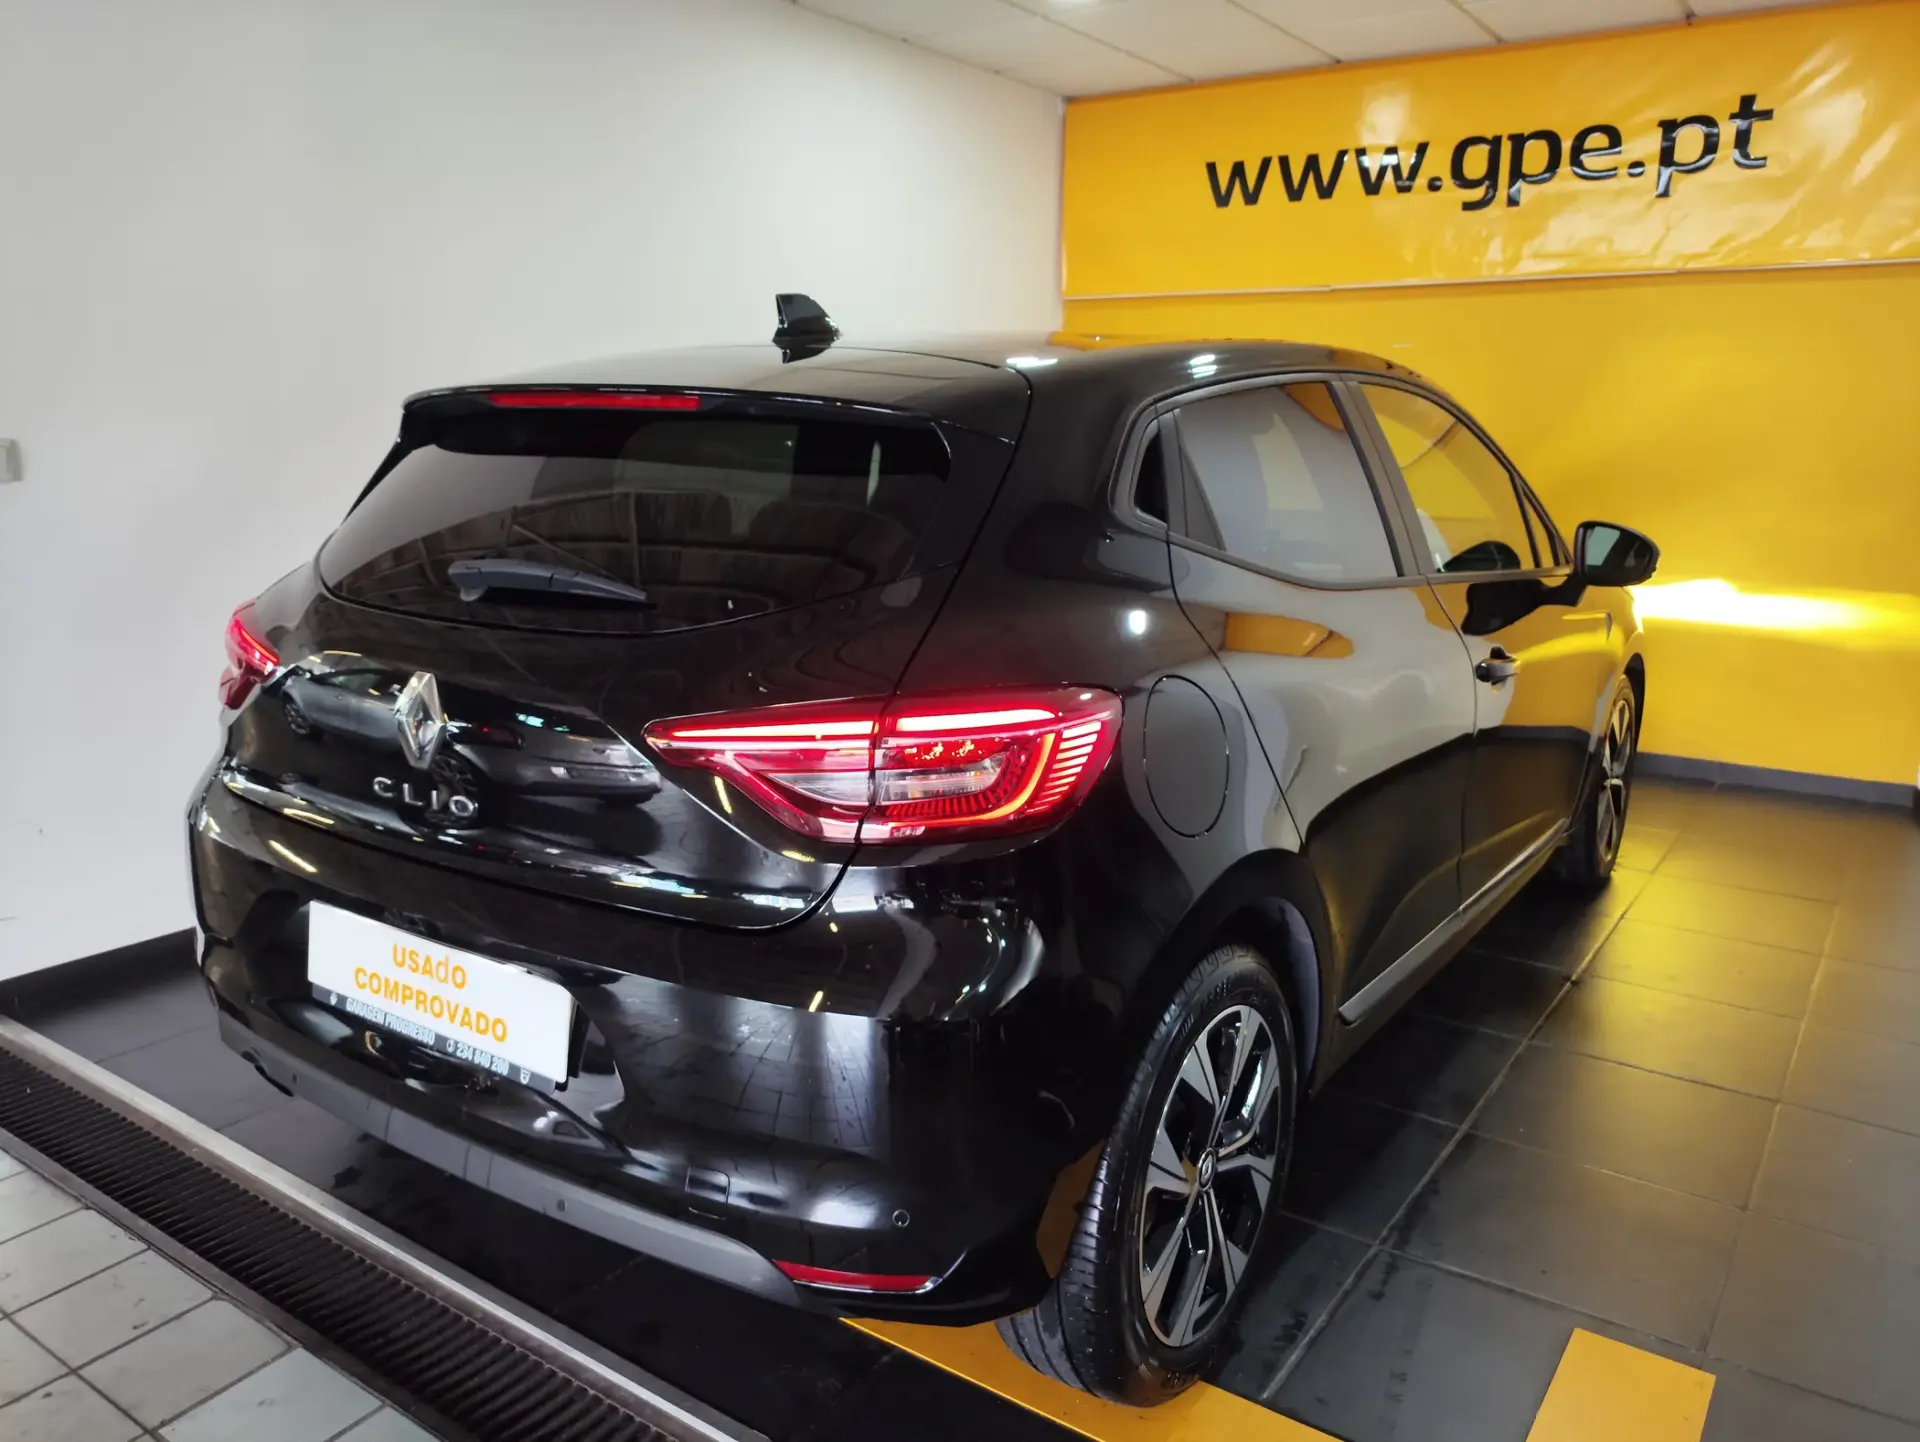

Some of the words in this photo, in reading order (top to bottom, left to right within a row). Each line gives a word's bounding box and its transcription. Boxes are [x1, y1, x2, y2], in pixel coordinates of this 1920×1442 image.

[1205, 94, 1774, 211] www.gpe.pt
[373, 777, 475, 817] CLIO
[354, 967, 508, 1043] COMPROVADO
[385, 1013, 435, 1046] PROGRESSO
[456, 1043, 473, 1061] 234
[491, 1056, 509, 1076] 200
